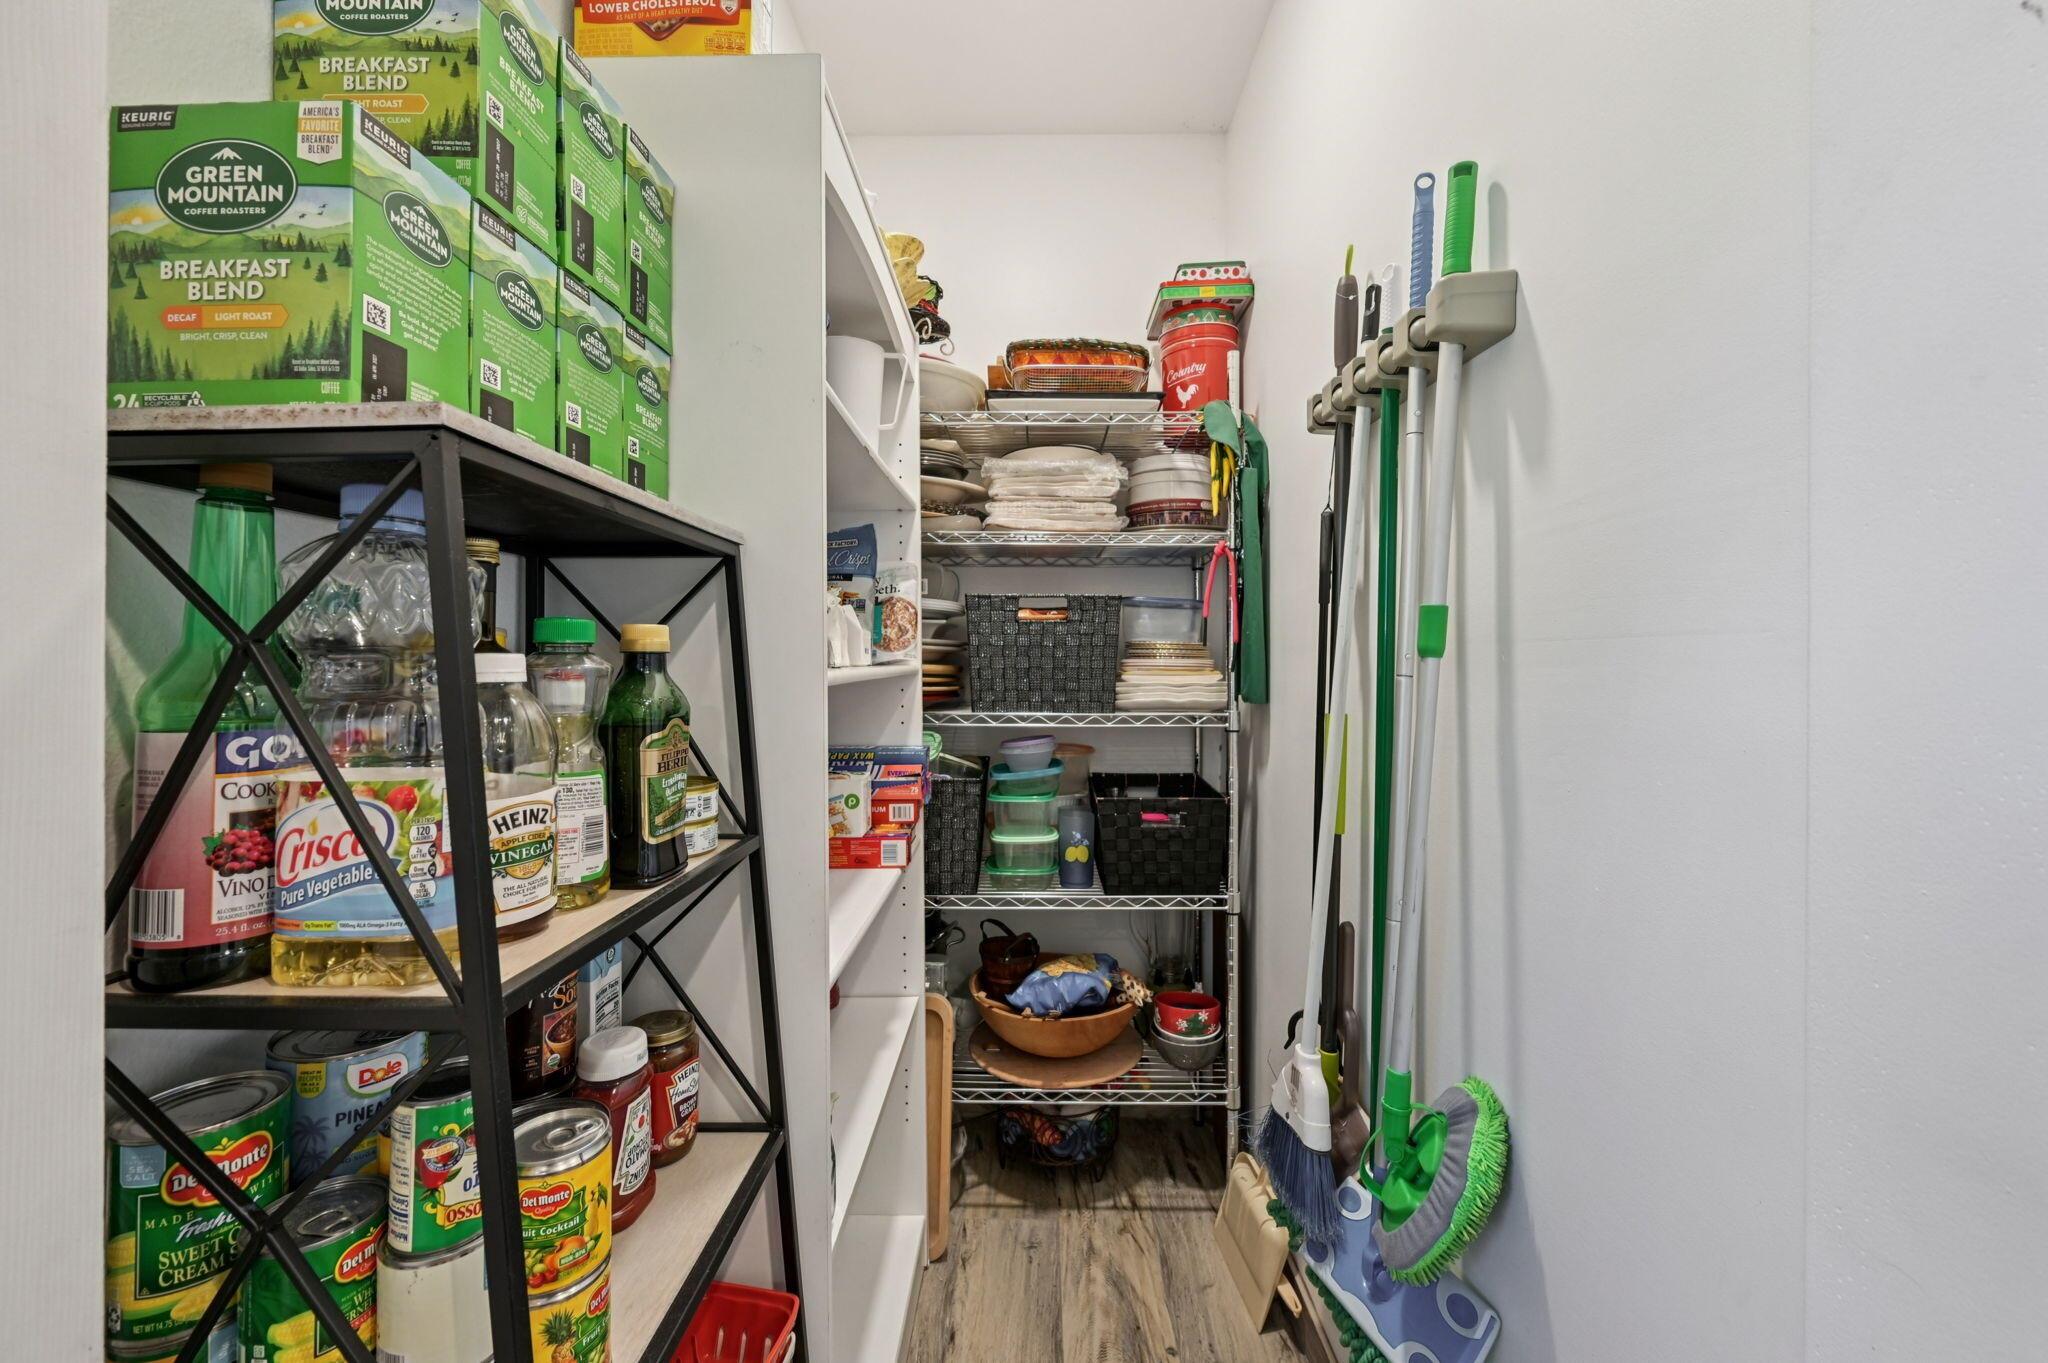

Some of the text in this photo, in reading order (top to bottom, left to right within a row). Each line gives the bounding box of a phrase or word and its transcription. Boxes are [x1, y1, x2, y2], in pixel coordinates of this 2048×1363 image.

[326, 0, 423, 10] MOUNTAIN
[589, 0, 716, 13] LOWER CHOLESTEROL
[503, 26, 542, 79] MOUNTAIN
[320, 57, 430, 73] BREAKFAST
[343, 74, 408, 90] BLEND
[499, 55, 545, 114] BREAKFAST
[373, 99, 403, 108] ROAST
[509, 79, 536, 115] BLEND
[121, 111, 172, 122] KEURIG
[302, 107, 340, 117] AMERICA'S
[301, 119, 339, 133] FAVORITE
[301, 134, 339, 145] BREAKFAST
[365, 118, 408, 158] KEURIG
[186, 165, 263, 184] GREEN
[167, 184, 284, 204] MOUNTAIN
[184, 206, 266, 215] COFFEE ROASTERS
[400, 205, 439, 240] GREEN
[481, 213, 514, 242] KEURIG
[391, 210, 448, 259] MOUNTAIN
[160, 258, 291, 280] BREAKFAST
[188, 281, 265, 301] BLEND
[508, 281, 536, 308] GREEN
[500, 286, 542, 322] MOUNTAIN
[167, 311, 273, 323] DECAF LIGHT ROAST
[180, 331, 268, 342] BRIGHT, CRISP, CLEAN
[1167, 362, 1207, 384] Country
[113, 393, 140, 408] 24
[835, 550, 871, 570] Crisps
[830, 752, 875, 760] WAX PAP
[220, 782, 277, 800] COOK
[417, 826, 431, 835] 120
[493, 808, 549, 834] HEINZ
[501, 832, 546, 848] APPLE CIDER
[490, 839, 553, 865] VINEGAR
[217, 877, 265, 898] VINO
[281, 865, 373, 908] Pure Vegetable
[503, 889, 525, 898] CHOICE
[526, 885, 536, 893] FOR
[516, 882, 527, 890] ALL
[216, 926, 238, 937] 25.4
[359, 1060, 402, 1085] Dole
[335, 1101, 385, 1127] PINEA
[129, 1166, 154, 1174] SEA
[216, 1144, 268, 1176] Monte
[126, 1173, 155, 1182] SALT
[172, 1175, 199, 1193] De
[145, 1211, 194, 1230] MADE
[249, 1168, 280, 1194] WITH
[522, 1190, 570, 1207] Del Monte
[522, 1216, 580, 1238] uit Cocktail
[158, 1237, 224, 1270] SWEET
[158, 1254, 226, 1287] CREAM
[342, 1254, 363, 1274] Del
[582, 1326, 601, 1346] Fruit
